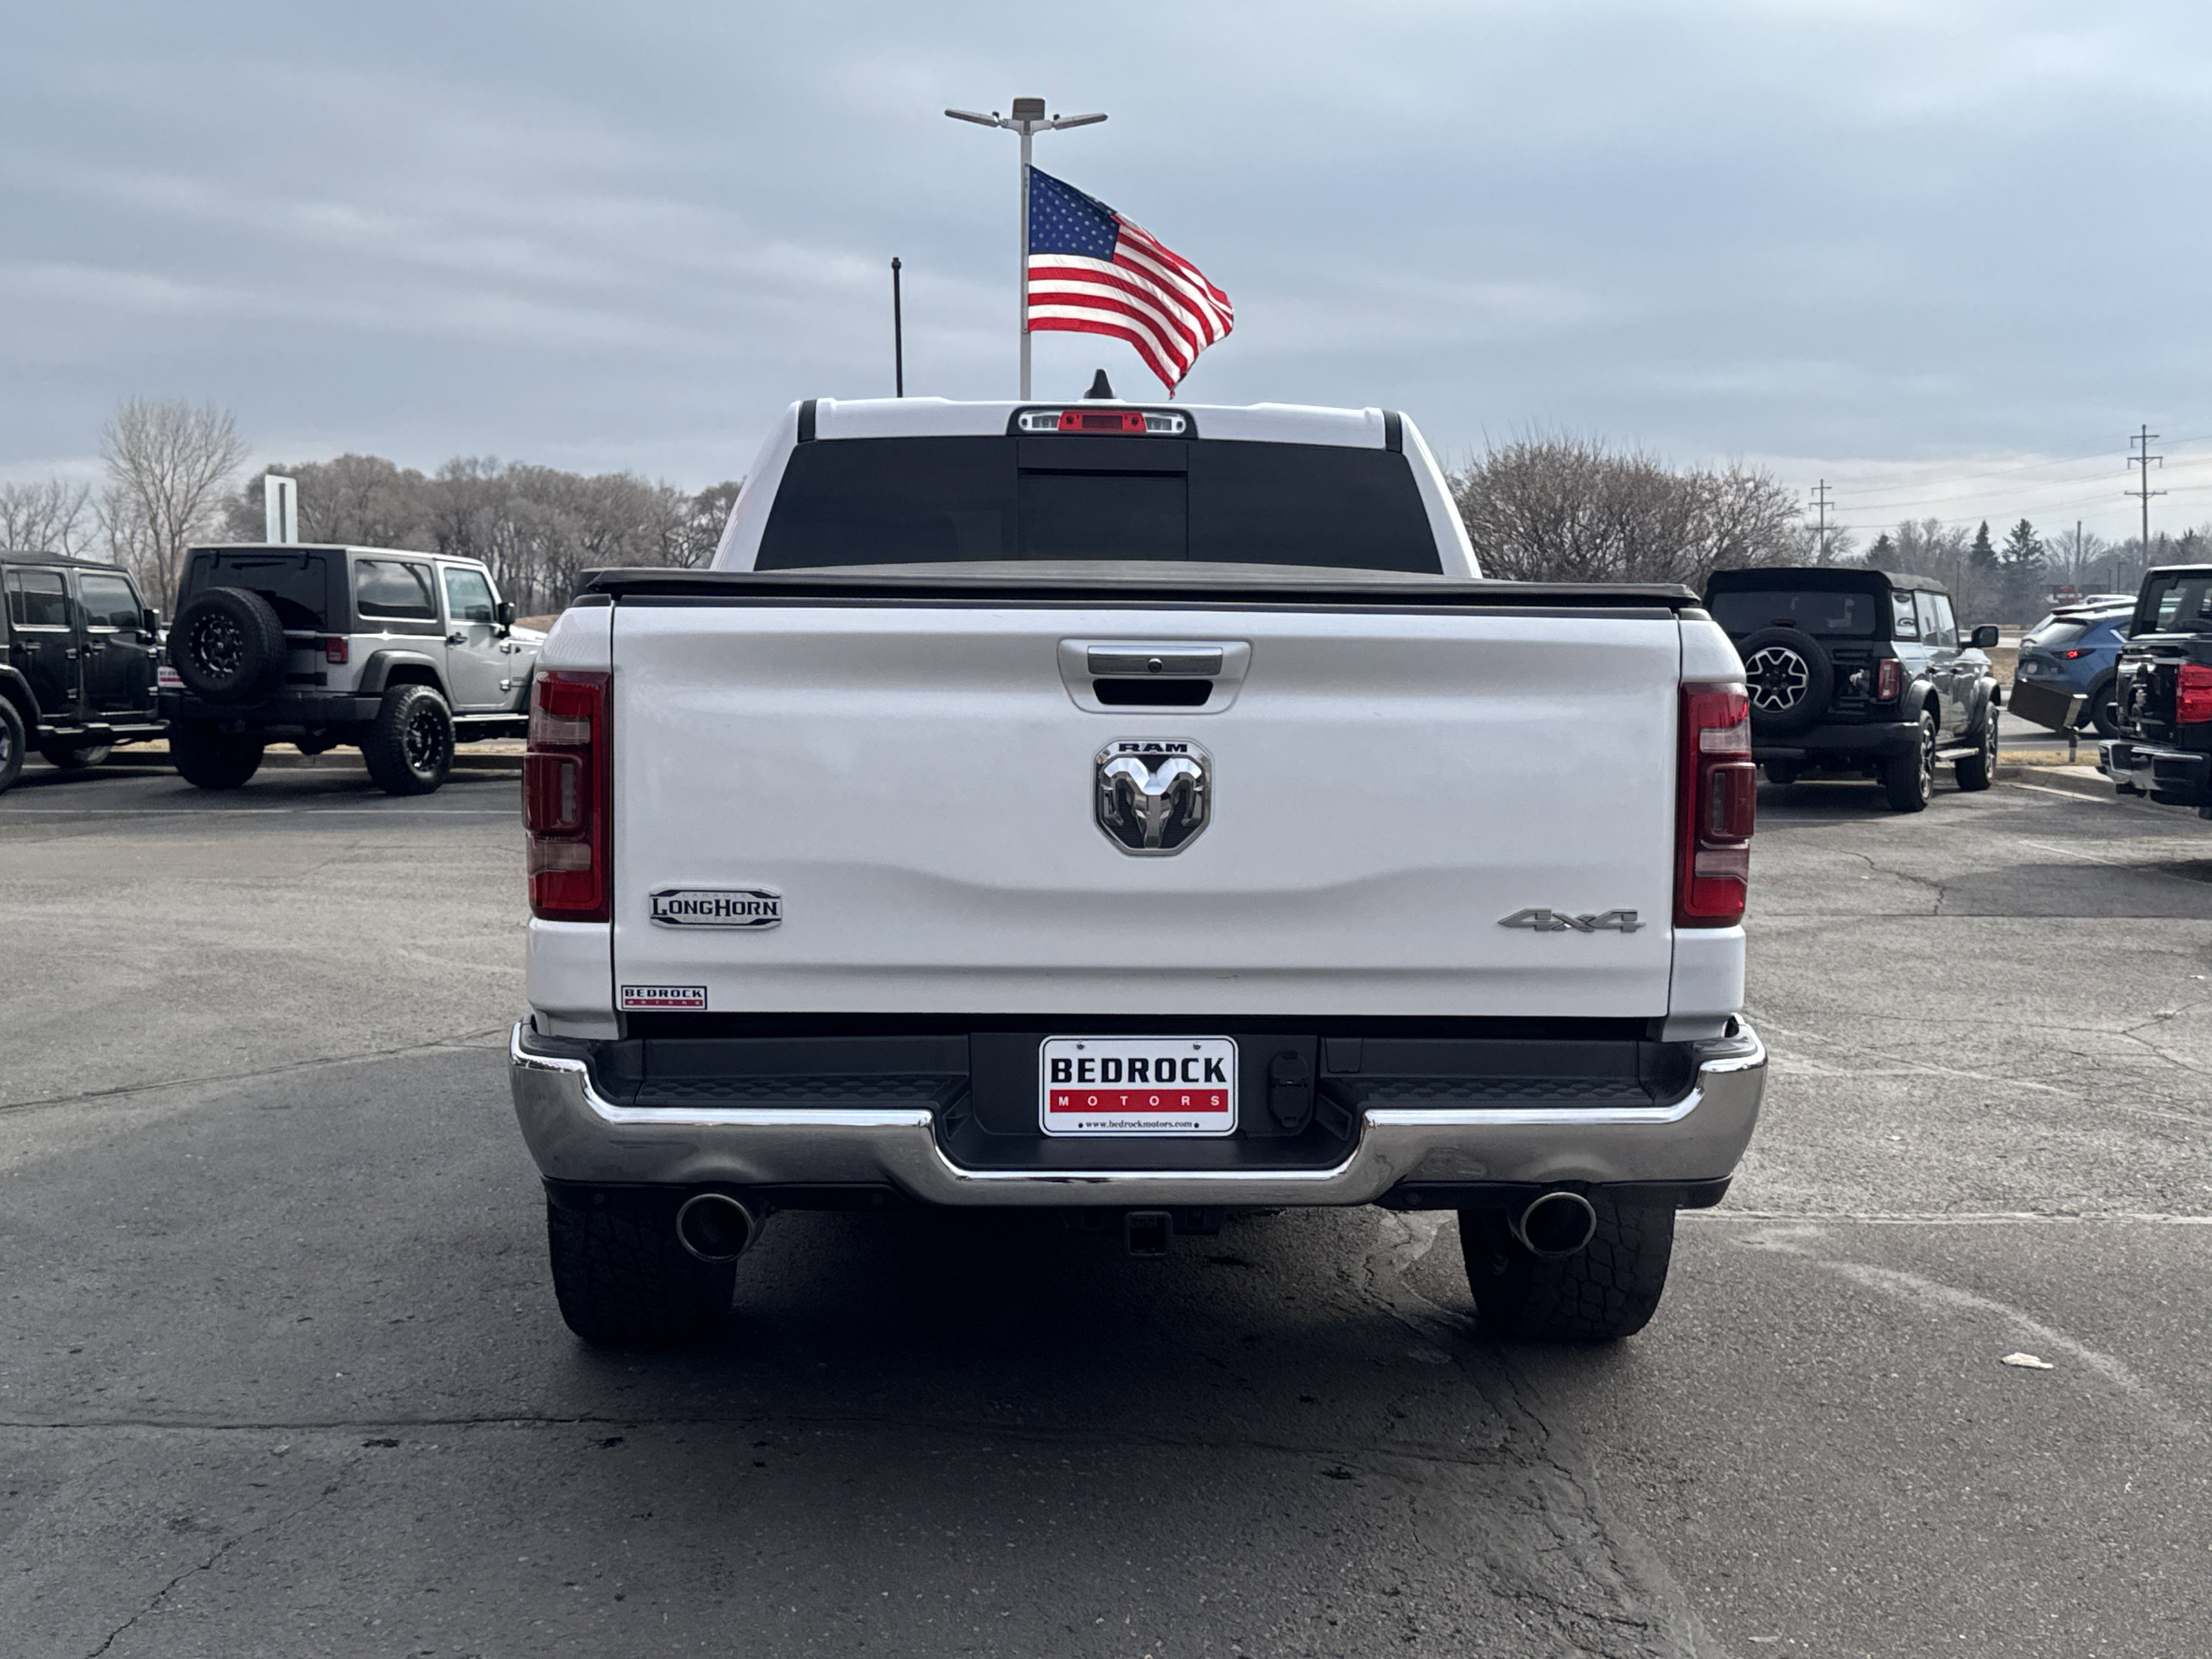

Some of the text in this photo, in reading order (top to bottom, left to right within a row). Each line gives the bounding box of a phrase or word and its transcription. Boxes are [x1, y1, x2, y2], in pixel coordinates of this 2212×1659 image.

[1119, 743, 1188, 753] RAM
[625, 989, 703, 998] BEDROCK
[1051, 1058, 1227, 1083] BEDROCK
[1058, 1096, 1220, 1107] MOTORS
[1086, 1120, 1192, 1128] www.bedrockmotors.com
